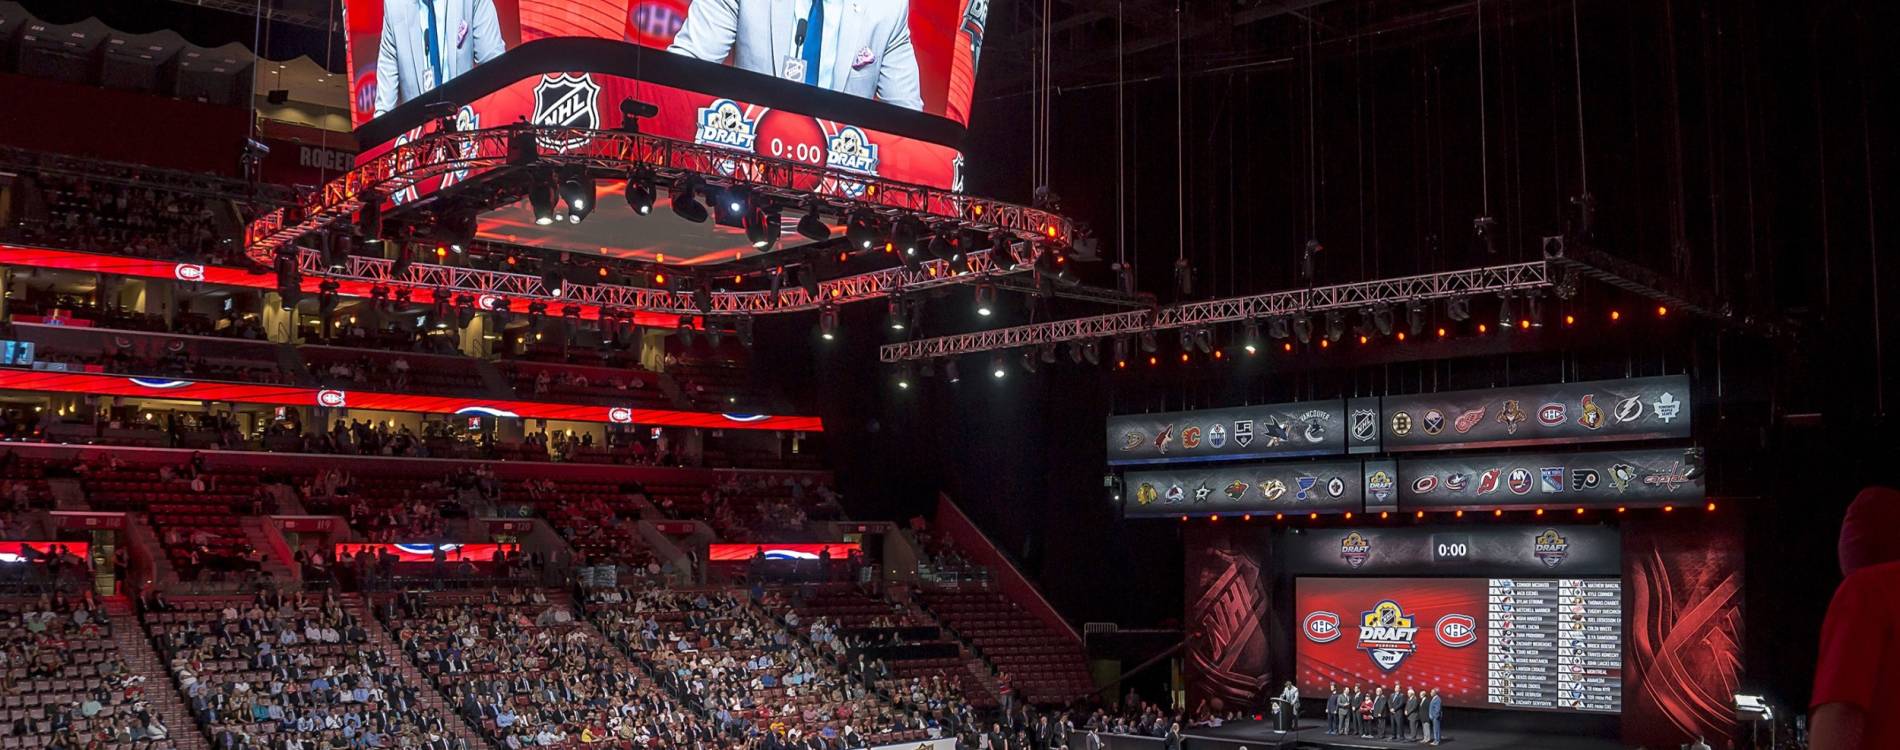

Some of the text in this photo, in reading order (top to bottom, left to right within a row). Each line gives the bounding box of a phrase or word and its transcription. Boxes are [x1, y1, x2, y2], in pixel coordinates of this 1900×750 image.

[545, 94, 585, 125] NHL
[701, 124, 754, 149] DRAFT
[771, 138, 821, 163] 0:00
[829, 149, 875, 170] DRAFT
[1301, 410, 1330, 422] VANCOUVER
[1236, 422, 1251, 432] LA
[1438, 543, 1467, 557] 0:00
[1535, 544, 1568, 552] DRAFT
[1359, 627, 1419, 641] DRAFT
